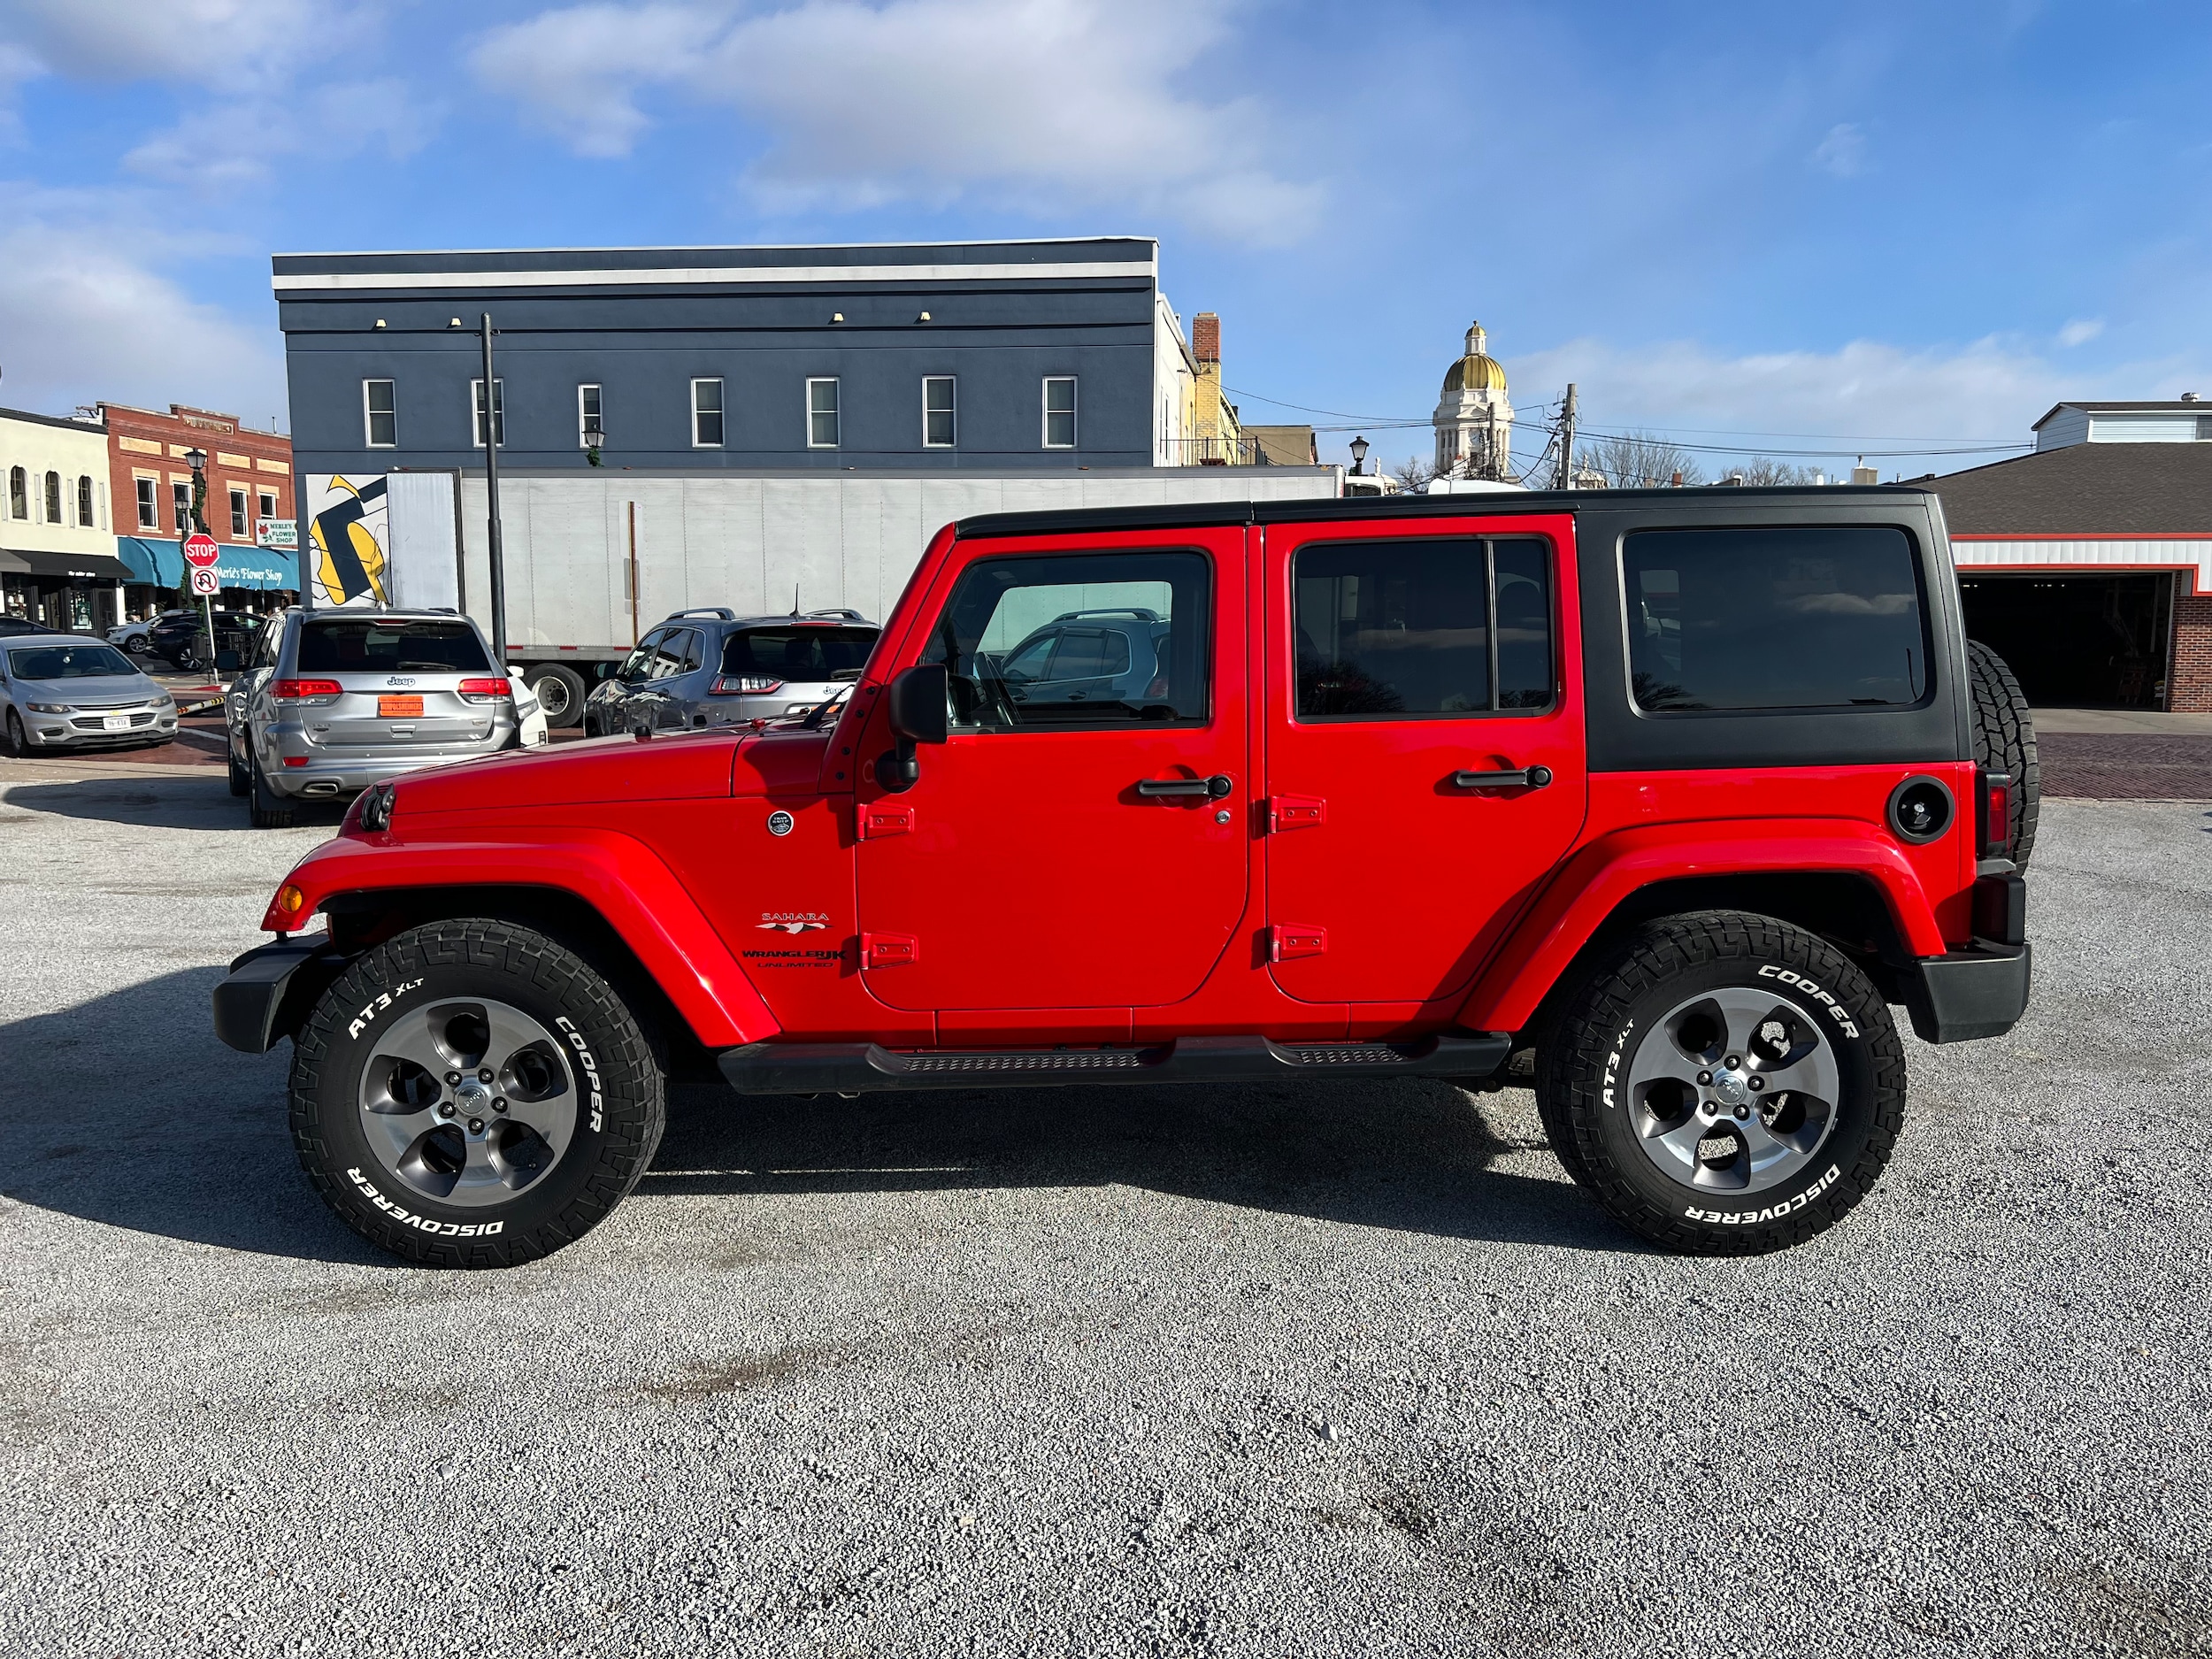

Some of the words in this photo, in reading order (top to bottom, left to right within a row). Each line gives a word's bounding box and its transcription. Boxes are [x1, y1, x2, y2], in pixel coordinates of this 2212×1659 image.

[187, 543, 216, 557] STOP
[215, 567, 240, 579] Merle's
[241, 568, 265, 580] Flower
[266, 569, 282, 586] Shop
[387, 676, 416, 687] Jeep
[349, 992, 393, 1040] AT3
[396, 978, 424, 997] XLT
[1758, 964, 1860, 1039] COOPER
[555, 1016, 603, 1133] COOPER
[1602, 1050, 1621, 1109] AT3
[1617, 1018, 1634, 1050] XLT
[347, 1166, 504, 1237] DISCOVERER
[1684, 1164, 1841, 1225] DISCOVERER
